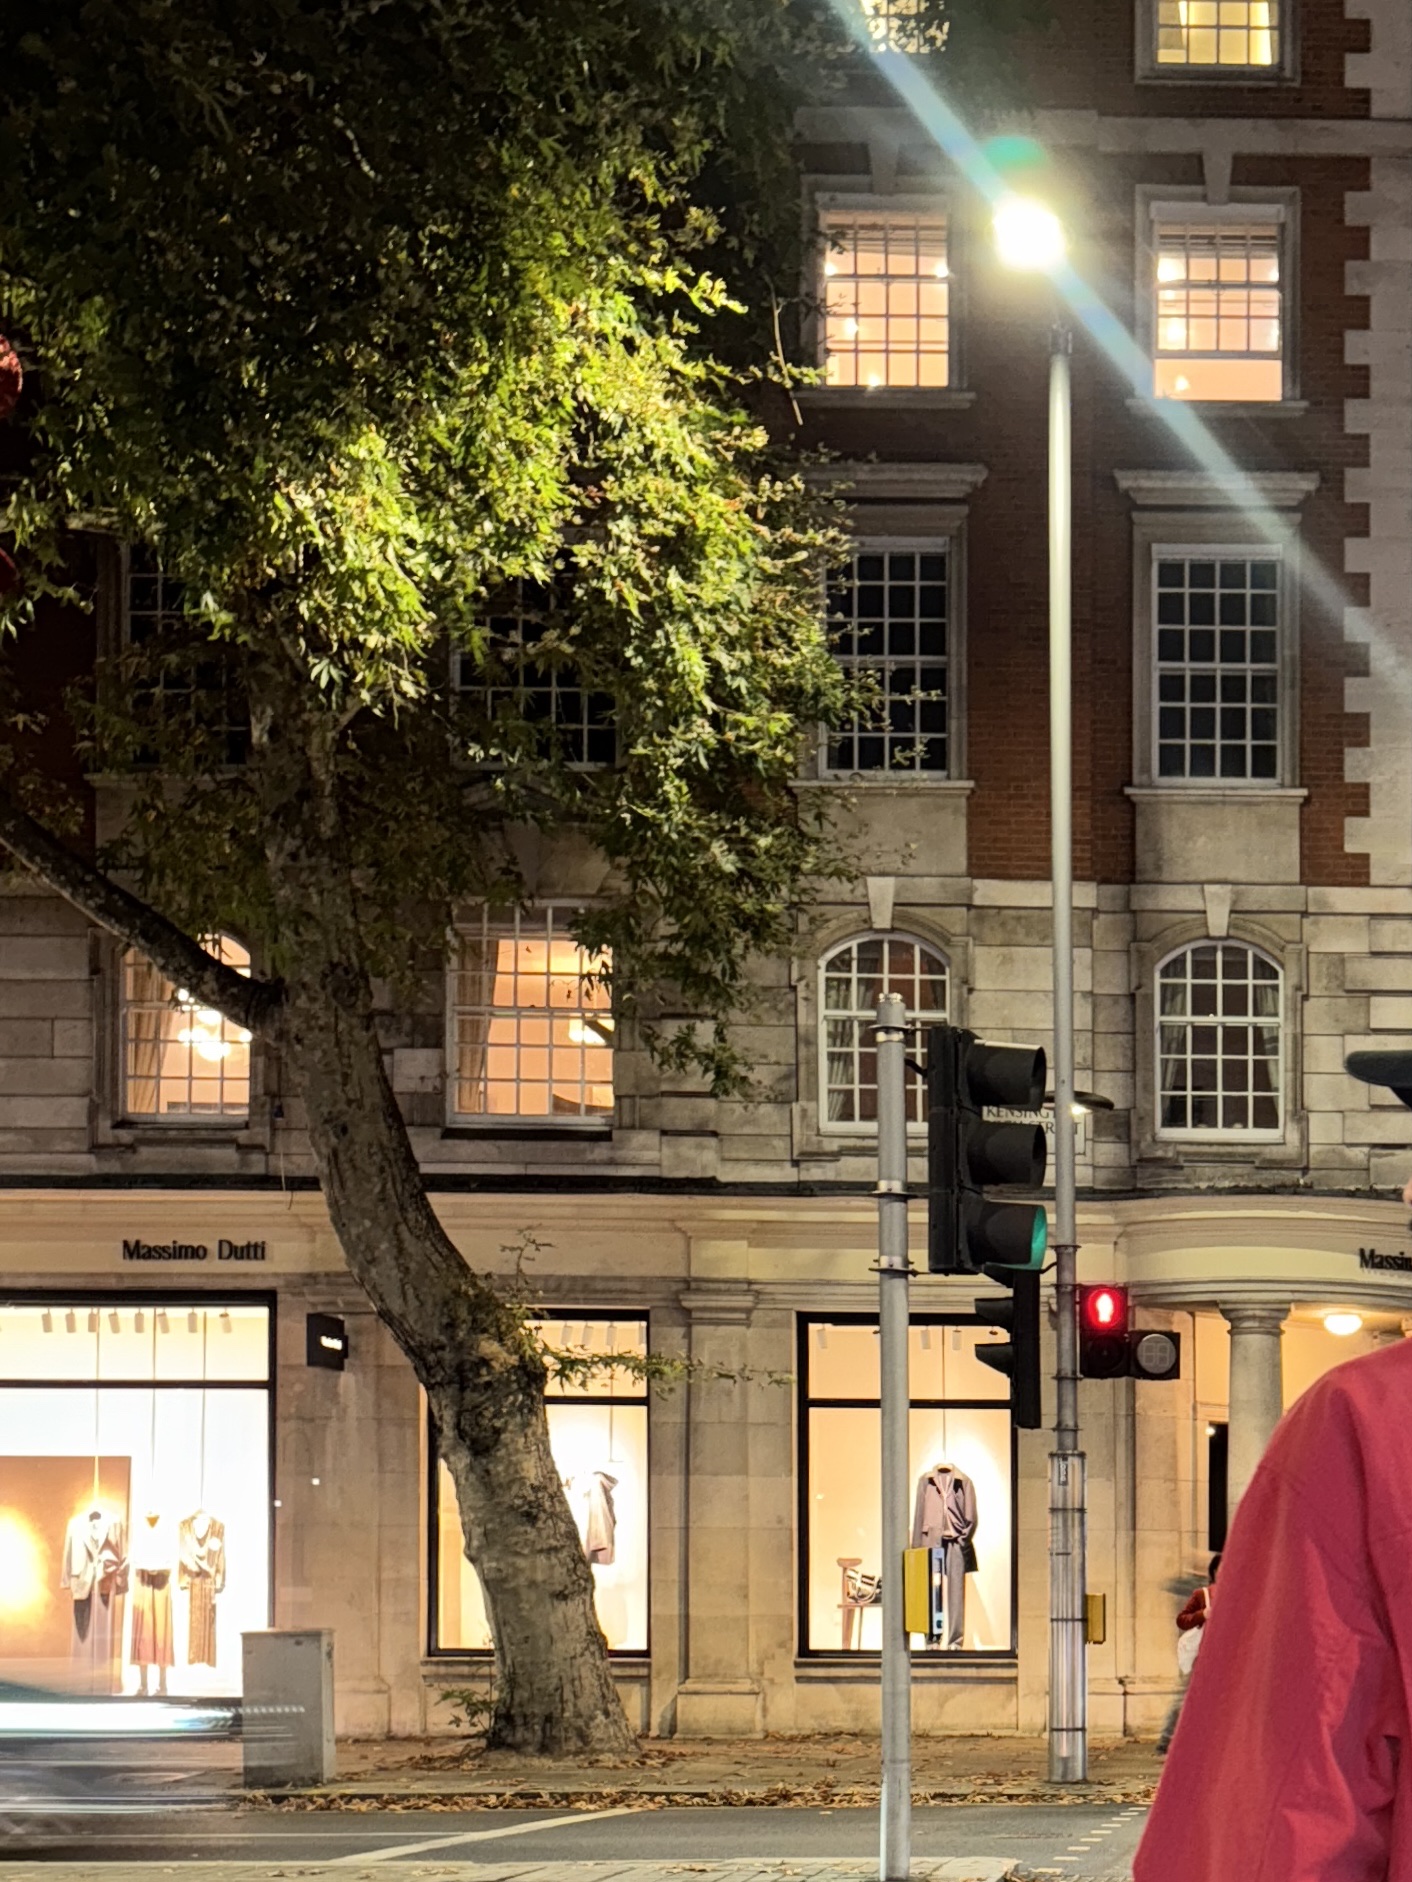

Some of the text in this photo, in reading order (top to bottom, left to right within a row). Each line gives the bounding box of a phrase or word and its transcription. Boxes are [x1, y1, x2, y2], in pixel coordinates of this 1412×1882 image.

[986, 1107, 1057, 1119] KENSING
[122, 1239, 266, 1260] Massimo Dutti
